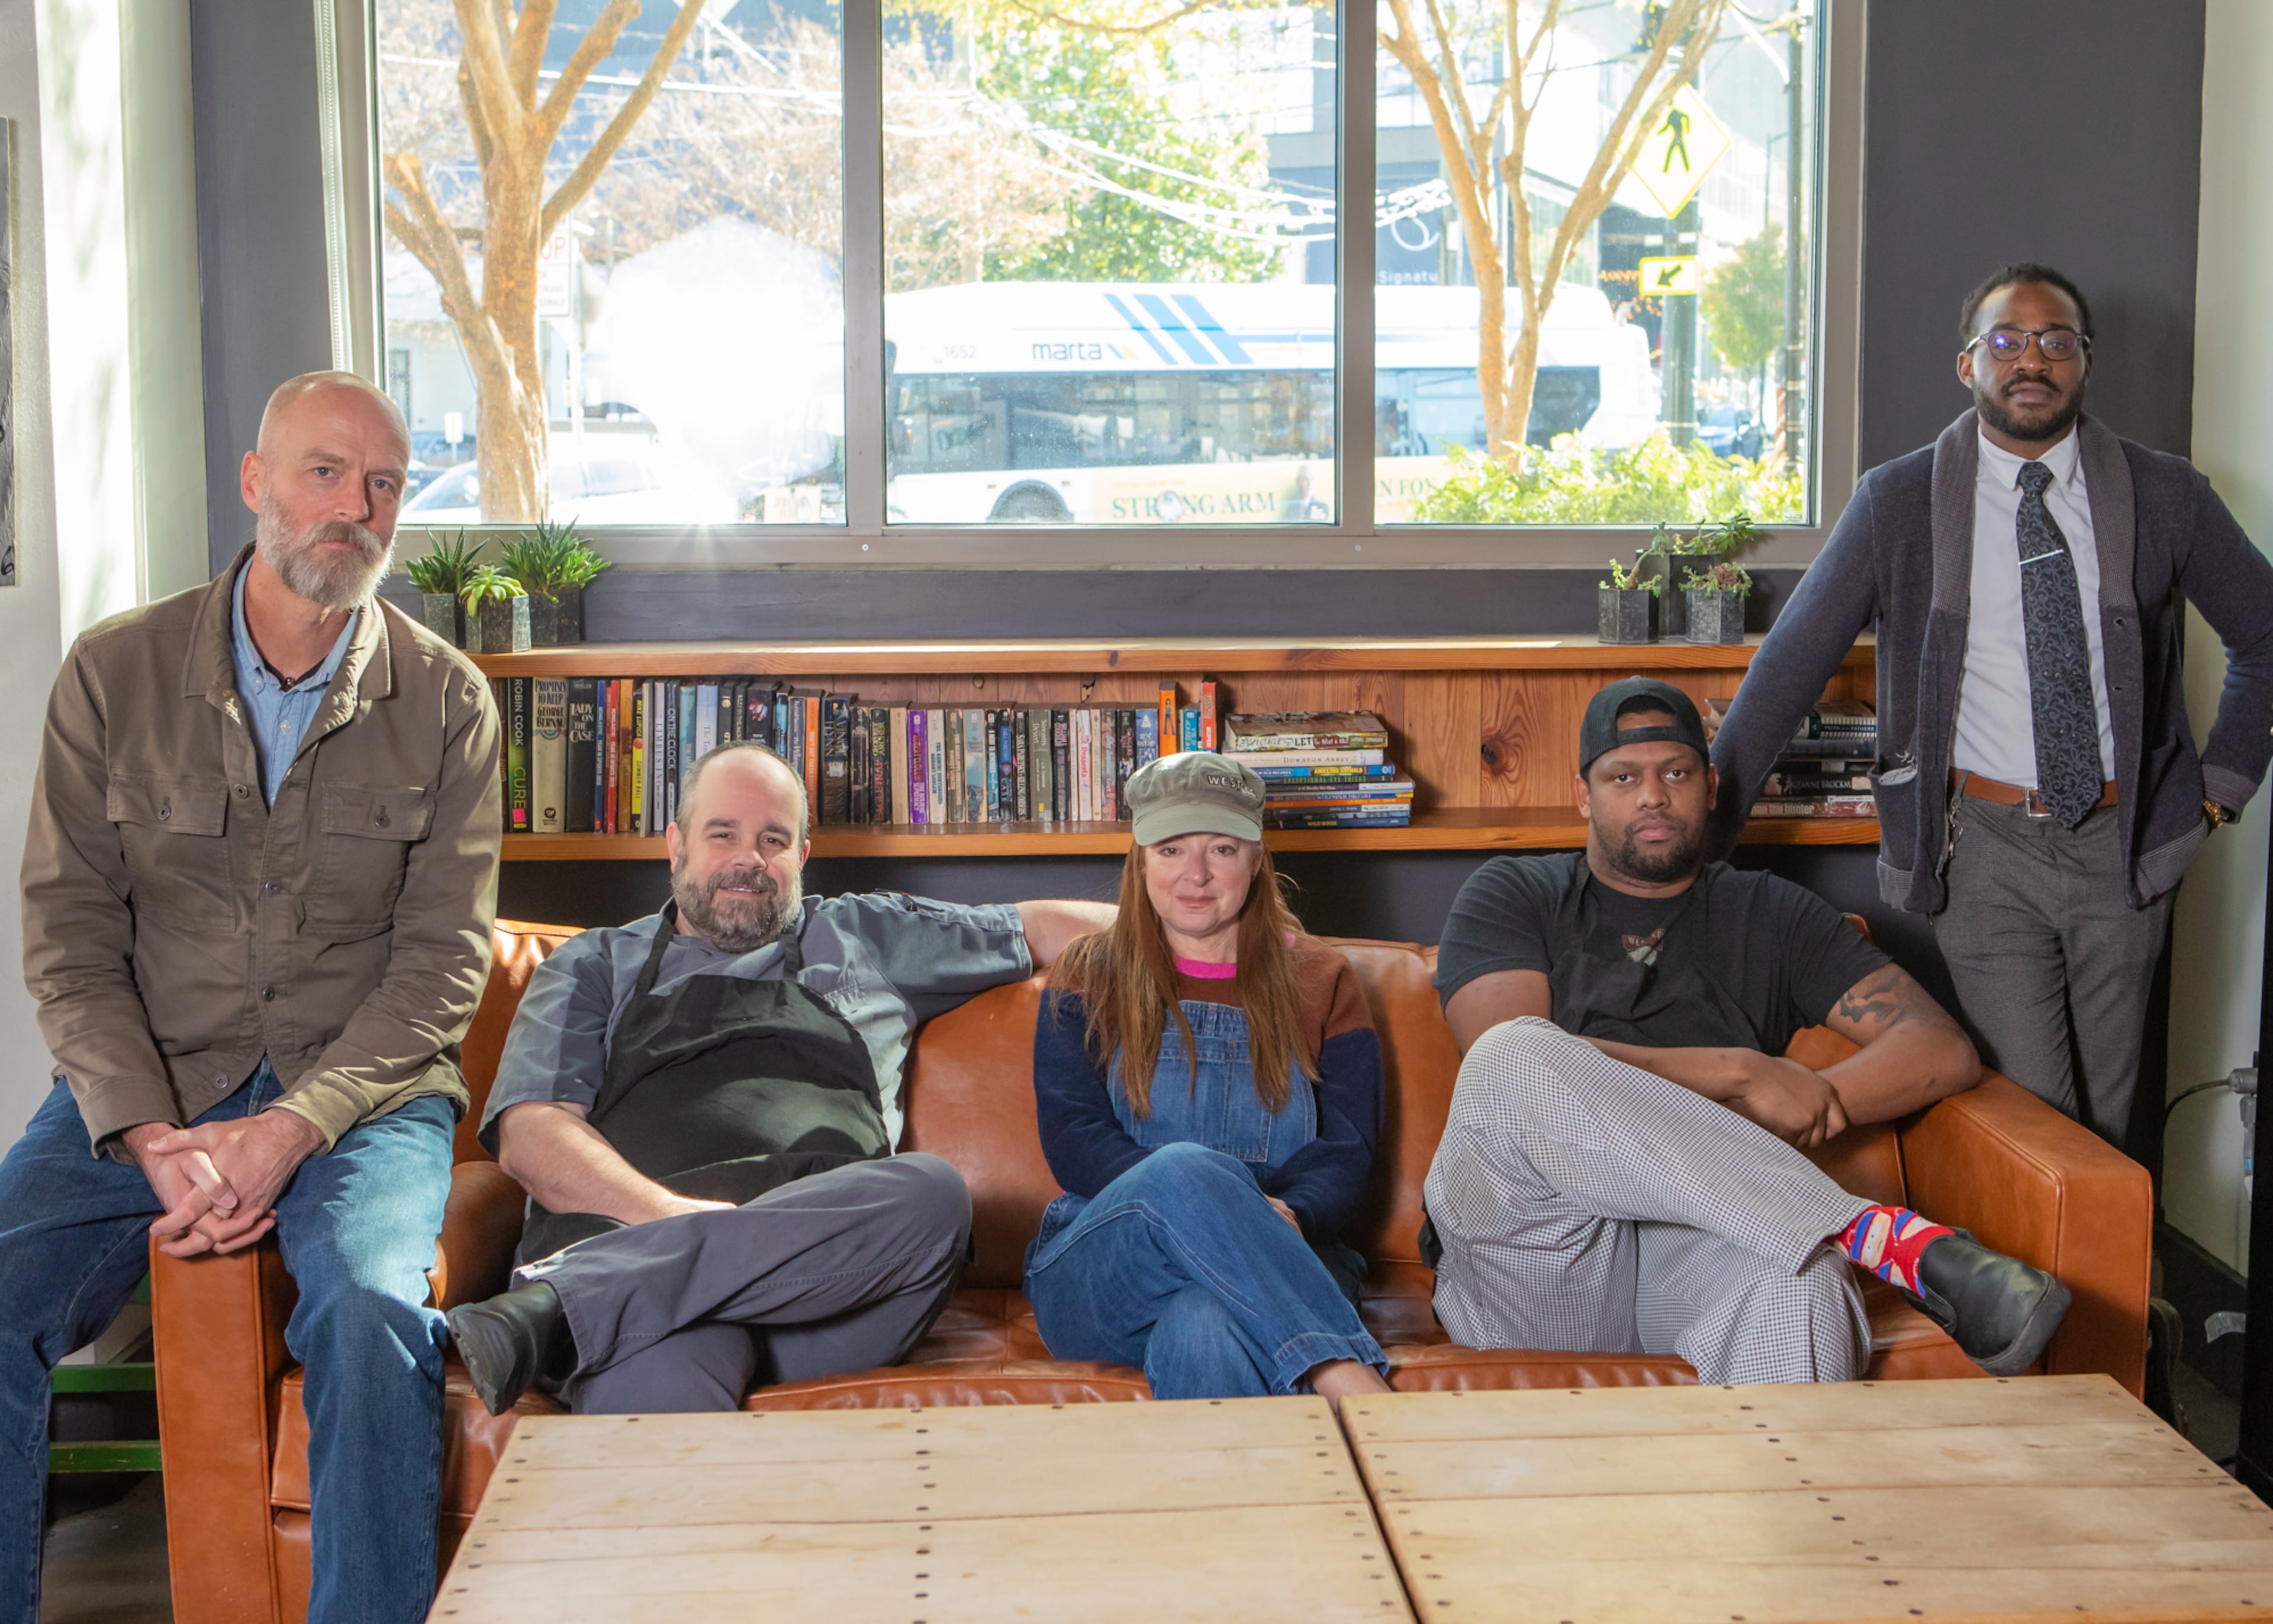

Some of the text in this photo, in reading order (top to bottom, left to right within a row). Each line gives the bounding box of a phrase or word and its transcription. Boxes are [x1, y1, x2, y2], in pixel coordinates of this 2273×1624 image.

[541, 237, 566, 260] OP
[1378, 270, 1438, 285] Signatu
[944, 345, 977, 359] 1652
[1032, 343, 1102, 360] marta
[1112, 492, 1275, 519] STRNG ARM
[535, 680, 566, 692] PROMISES
[538, 693, 564, 704] TO KEEP
[514, 679, 524, 746] ROBIN COOK
[537, 706, 564, 717] GEORGE
[569, 703, 594, 716] LADY
[668, 707, 676, 721] ON
[569, 729, 594, 743] CASE
[703, 725, 711, 739] The
[823, 720, 835, 757] FLYNN
[834, 720, 846, 759] VINCE
[1032, 722, 1040, 745] Desert
[1016, 734, 1025, 749] SARA
[1248, 737, 1282, 746] SPECTACLE
[1294, 737, 1312, 746] LET
[668, 739, 676, 769] CLOCK
[1016, 748, 1026, 774] PARETSKY
[1080, 746, 1089, 778] Desserts
[513, 767, 526, 809] CURE
[874, 758, 884, 821] EAGLETRAP
[1208, 775, 1241, 790] WEST
[1821, 780, 1852, 788] BROCKM
[1769, 804, 1784, 814] the
[1784, 803, 1814, 814] hunter
